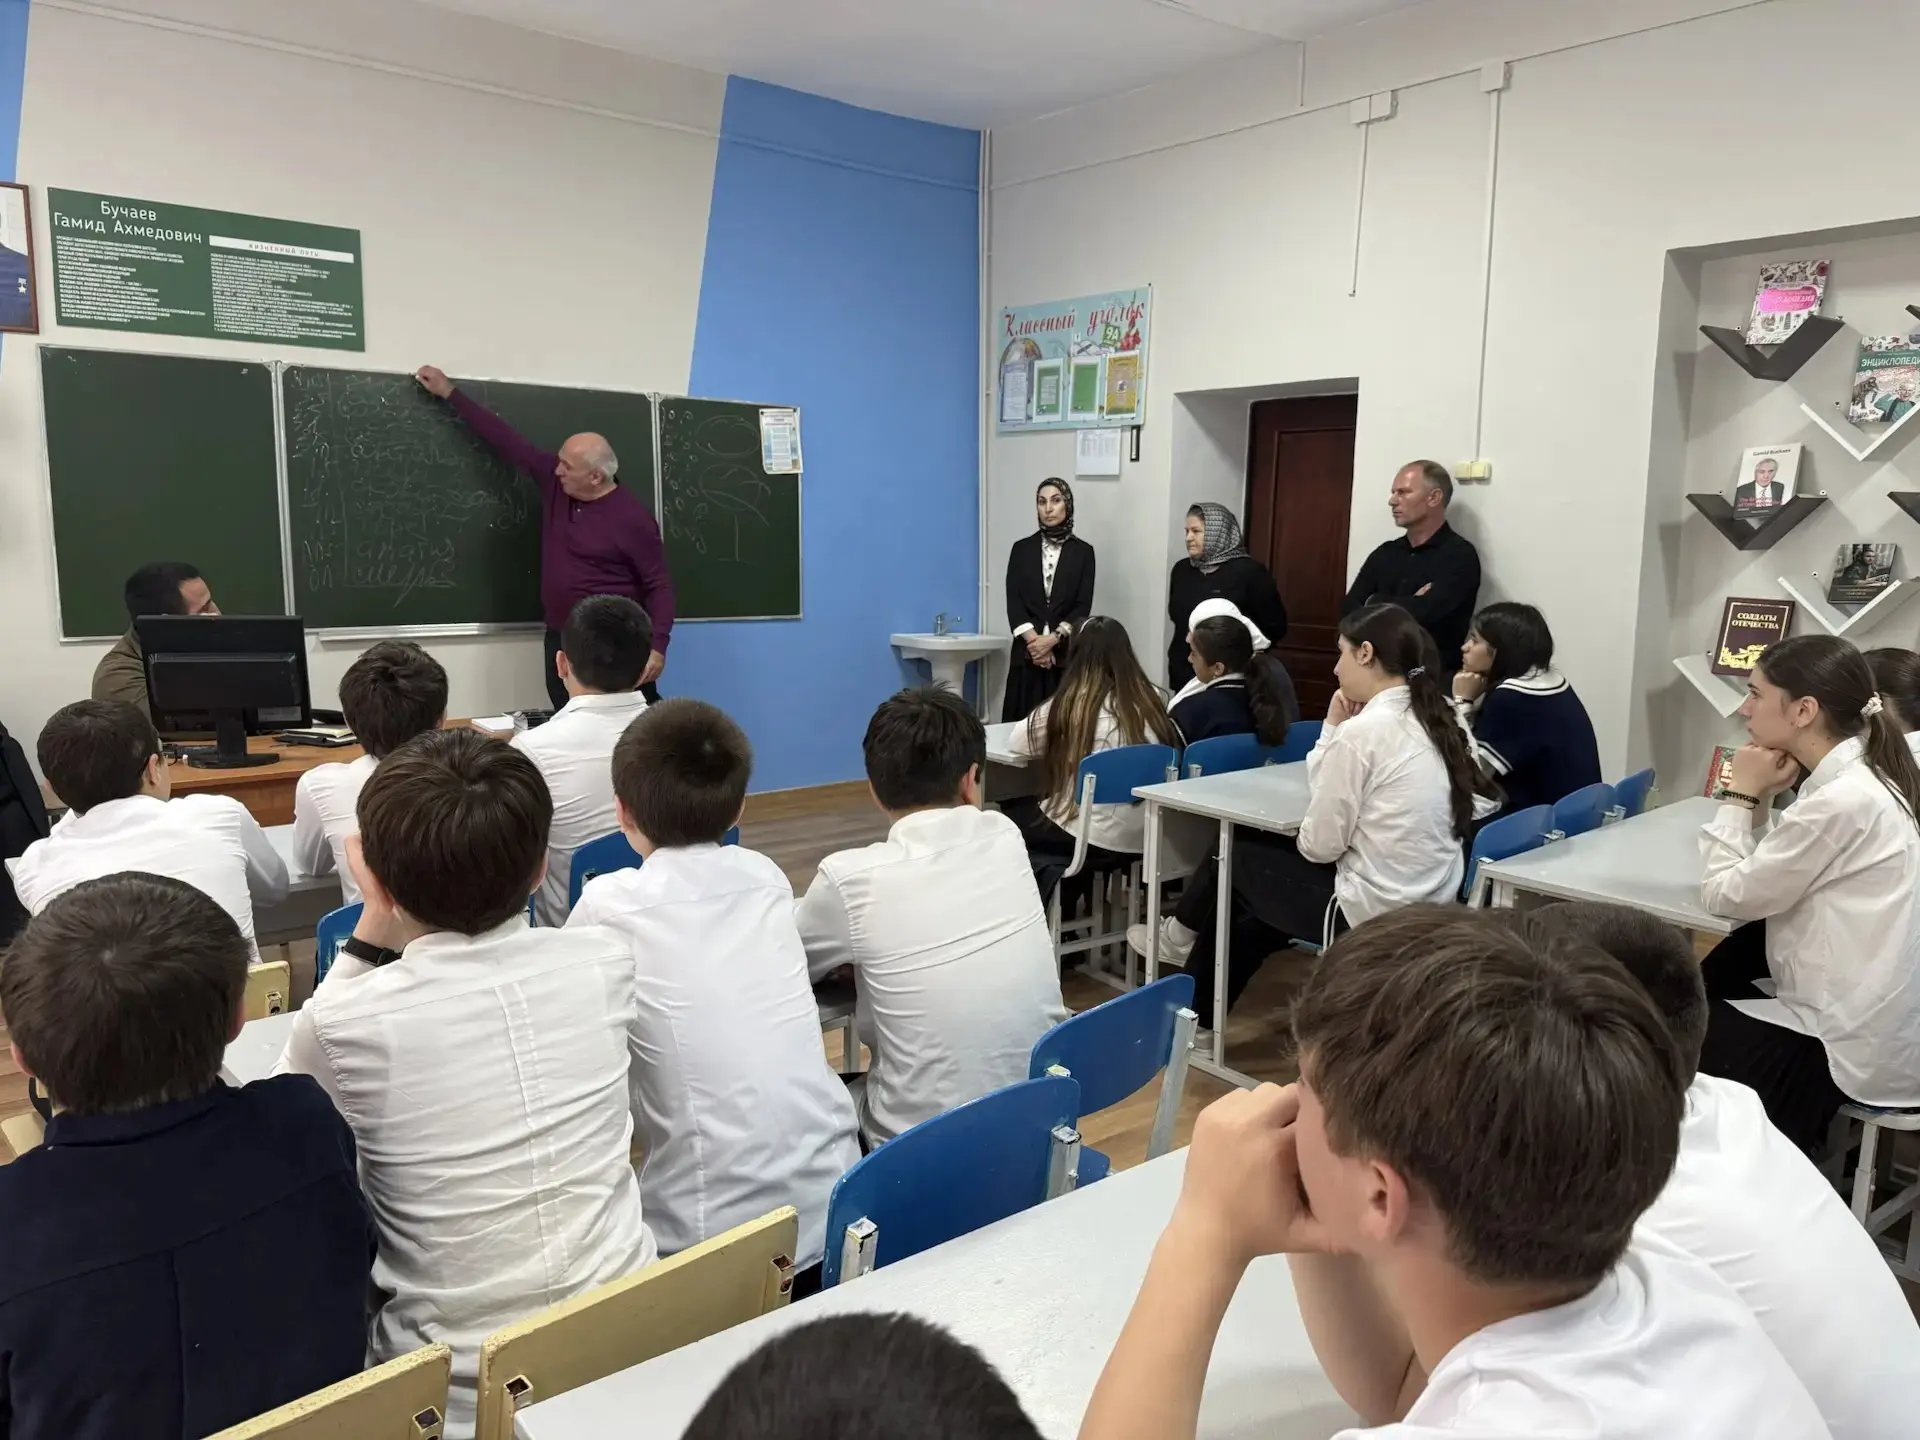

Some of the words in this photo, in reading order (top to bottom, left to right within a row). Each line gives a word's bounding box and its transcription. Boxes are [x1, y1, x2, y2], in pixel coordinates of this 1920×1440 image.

[100, 200, 157, 222] Бучаев
[53, 211, 106, 234] Гамид
[114, 219, 202, 244] Ахмедович
[1004, 309, 1076, 337] Классный
[1086, 302, 1145, 337] уголок
[1731, 619, 1779, 629] ОТЕЧЕСТВА
[1737, 612, 1777, 622] СОЛДАТЫ
